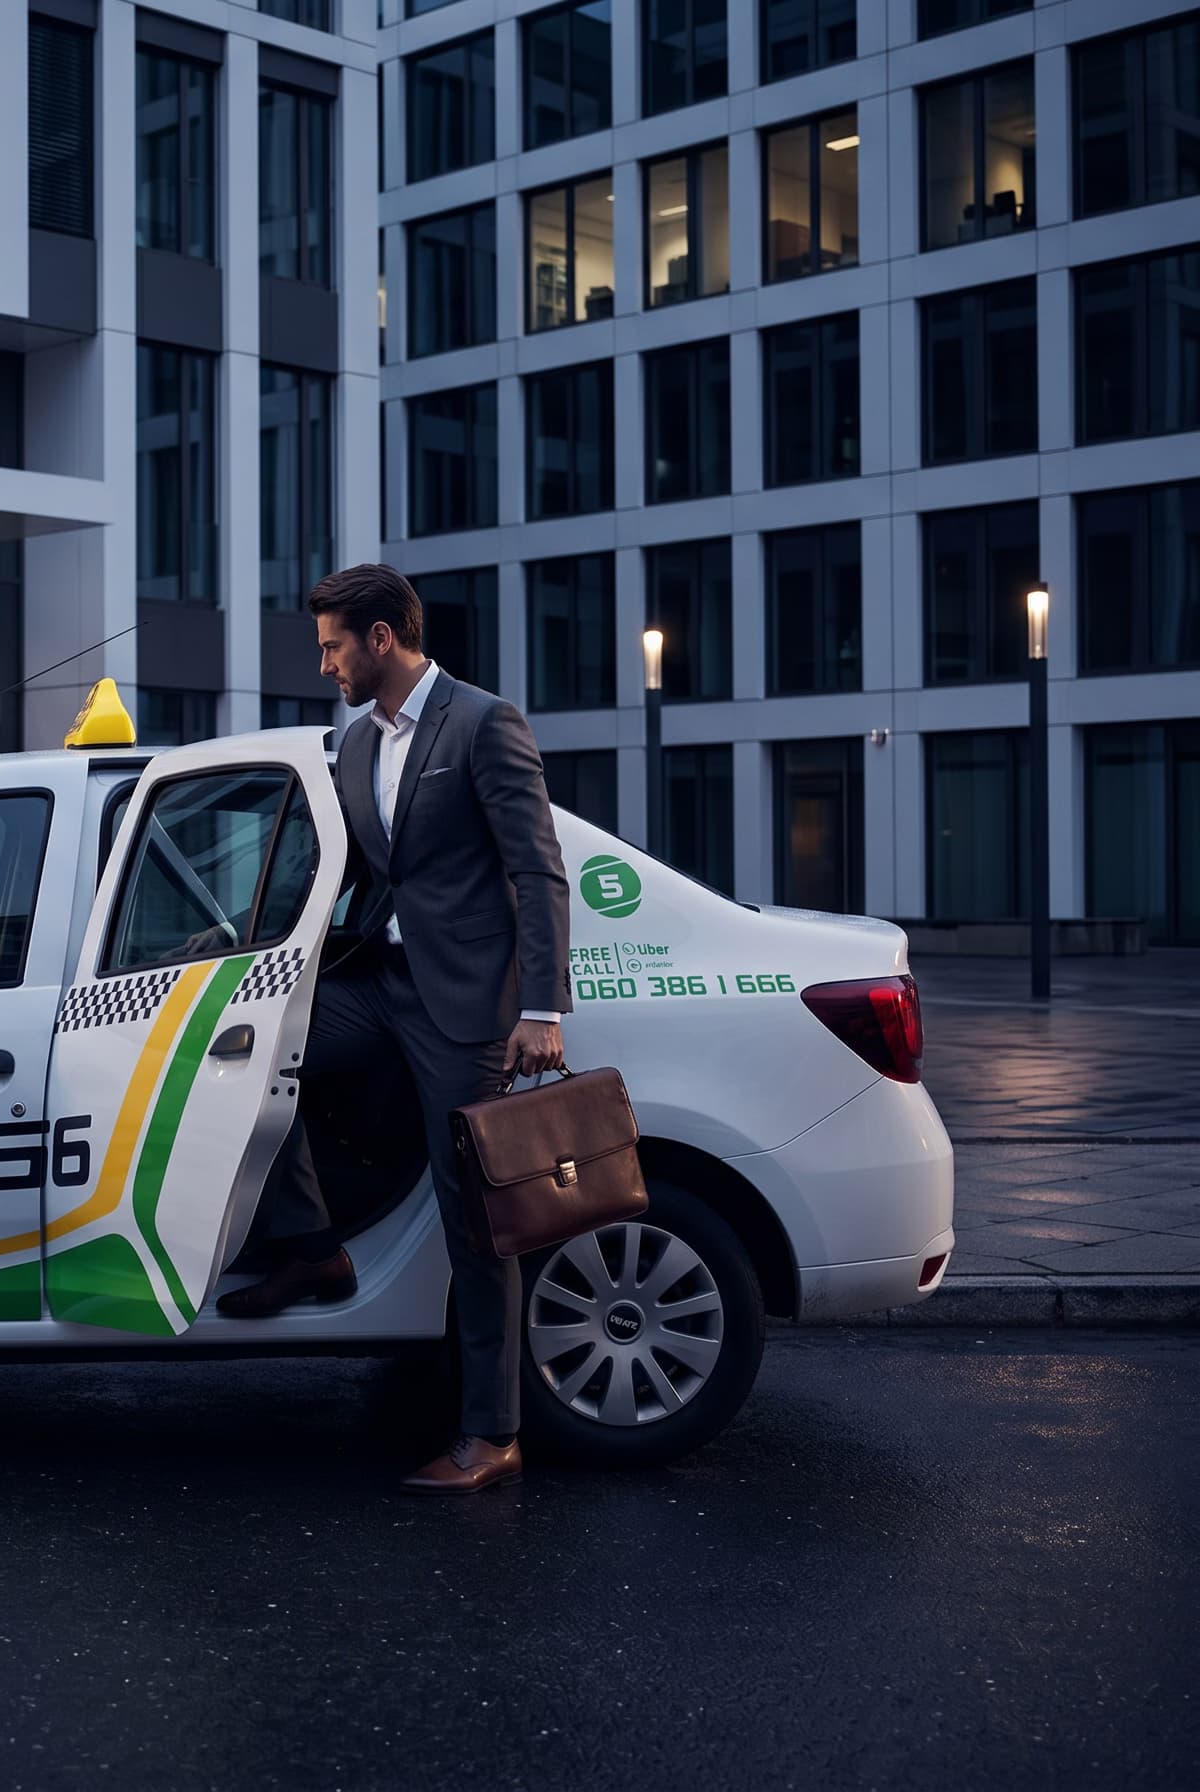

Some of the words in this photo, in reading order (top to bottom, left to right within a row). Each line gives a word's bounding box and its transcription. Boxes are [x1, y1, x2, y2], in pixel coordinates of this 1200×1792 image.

[597, 874, 623, 899] 5
[569, 947, 611, 962] FREE
[572, 962, 615, 976] CALL
[576, 978, 637, 1000] 060
[647, 975, 708, 997] 386
[735, 974, 796, 994] 666
